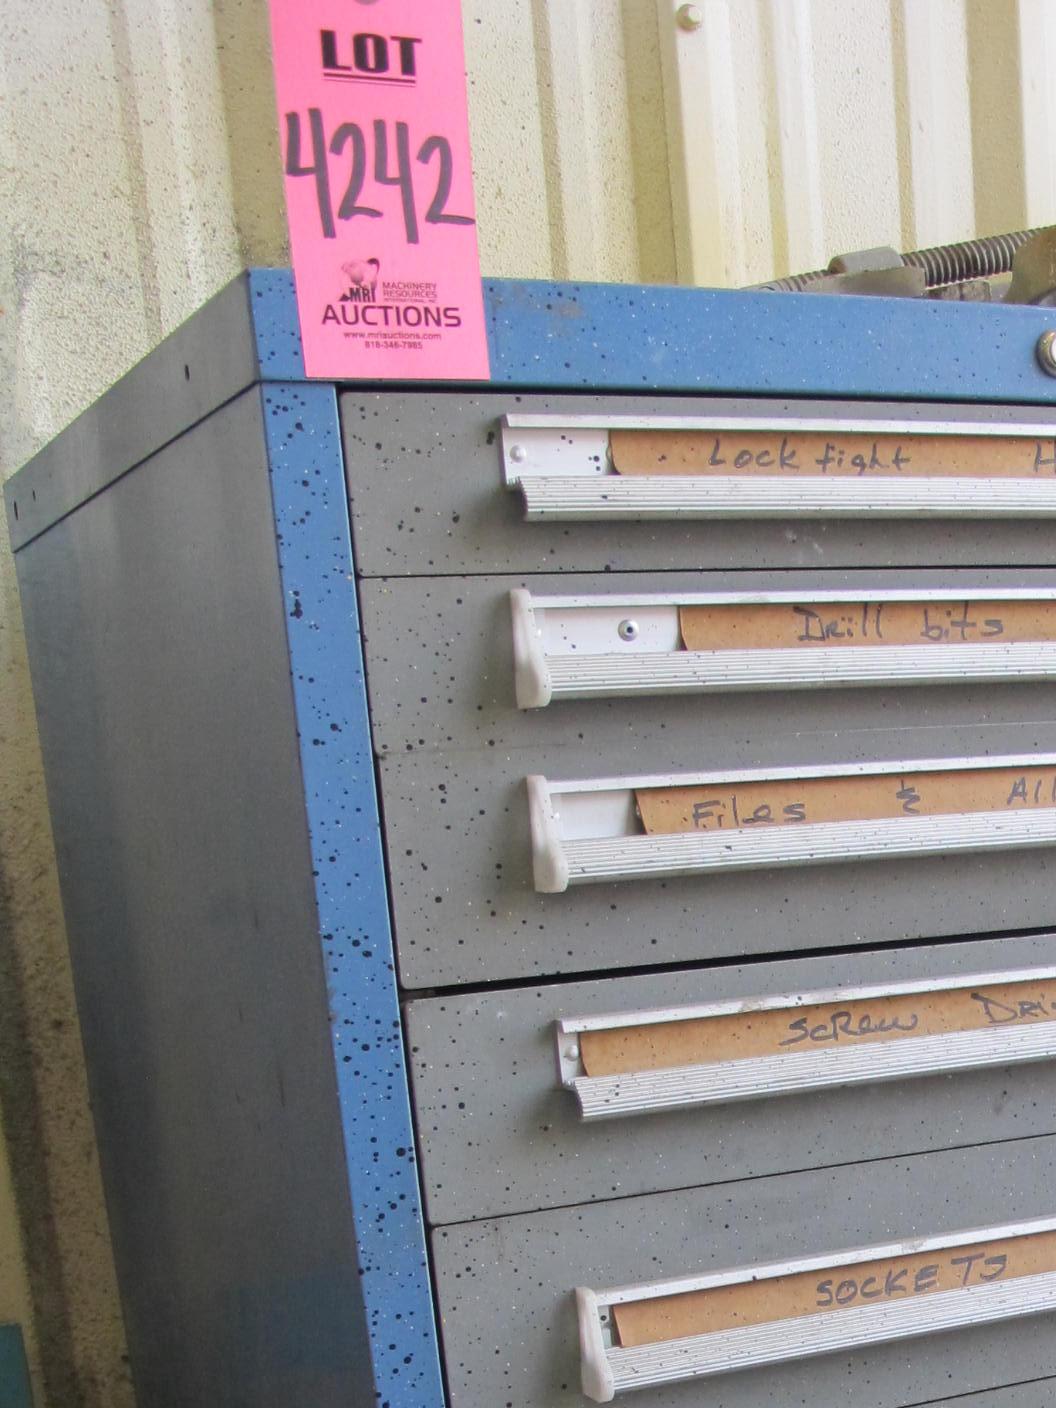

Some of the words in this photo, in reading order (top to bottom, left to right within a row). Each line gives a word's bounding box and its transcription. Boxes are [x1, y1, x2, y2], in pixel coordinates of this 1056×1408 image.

[320, 29, 422, 77] LOT
[285, 107, 475, 244] 4242
[382, 281, 437, 291] MACHINERY
[383, 290, 438, 299] RESOURCES
[322, 304, 462, 328] AUCTIONS
[343, 331, 442, 340] www.mriauctions.com
[816, 1252, 1008, 1308] SOCKETS
